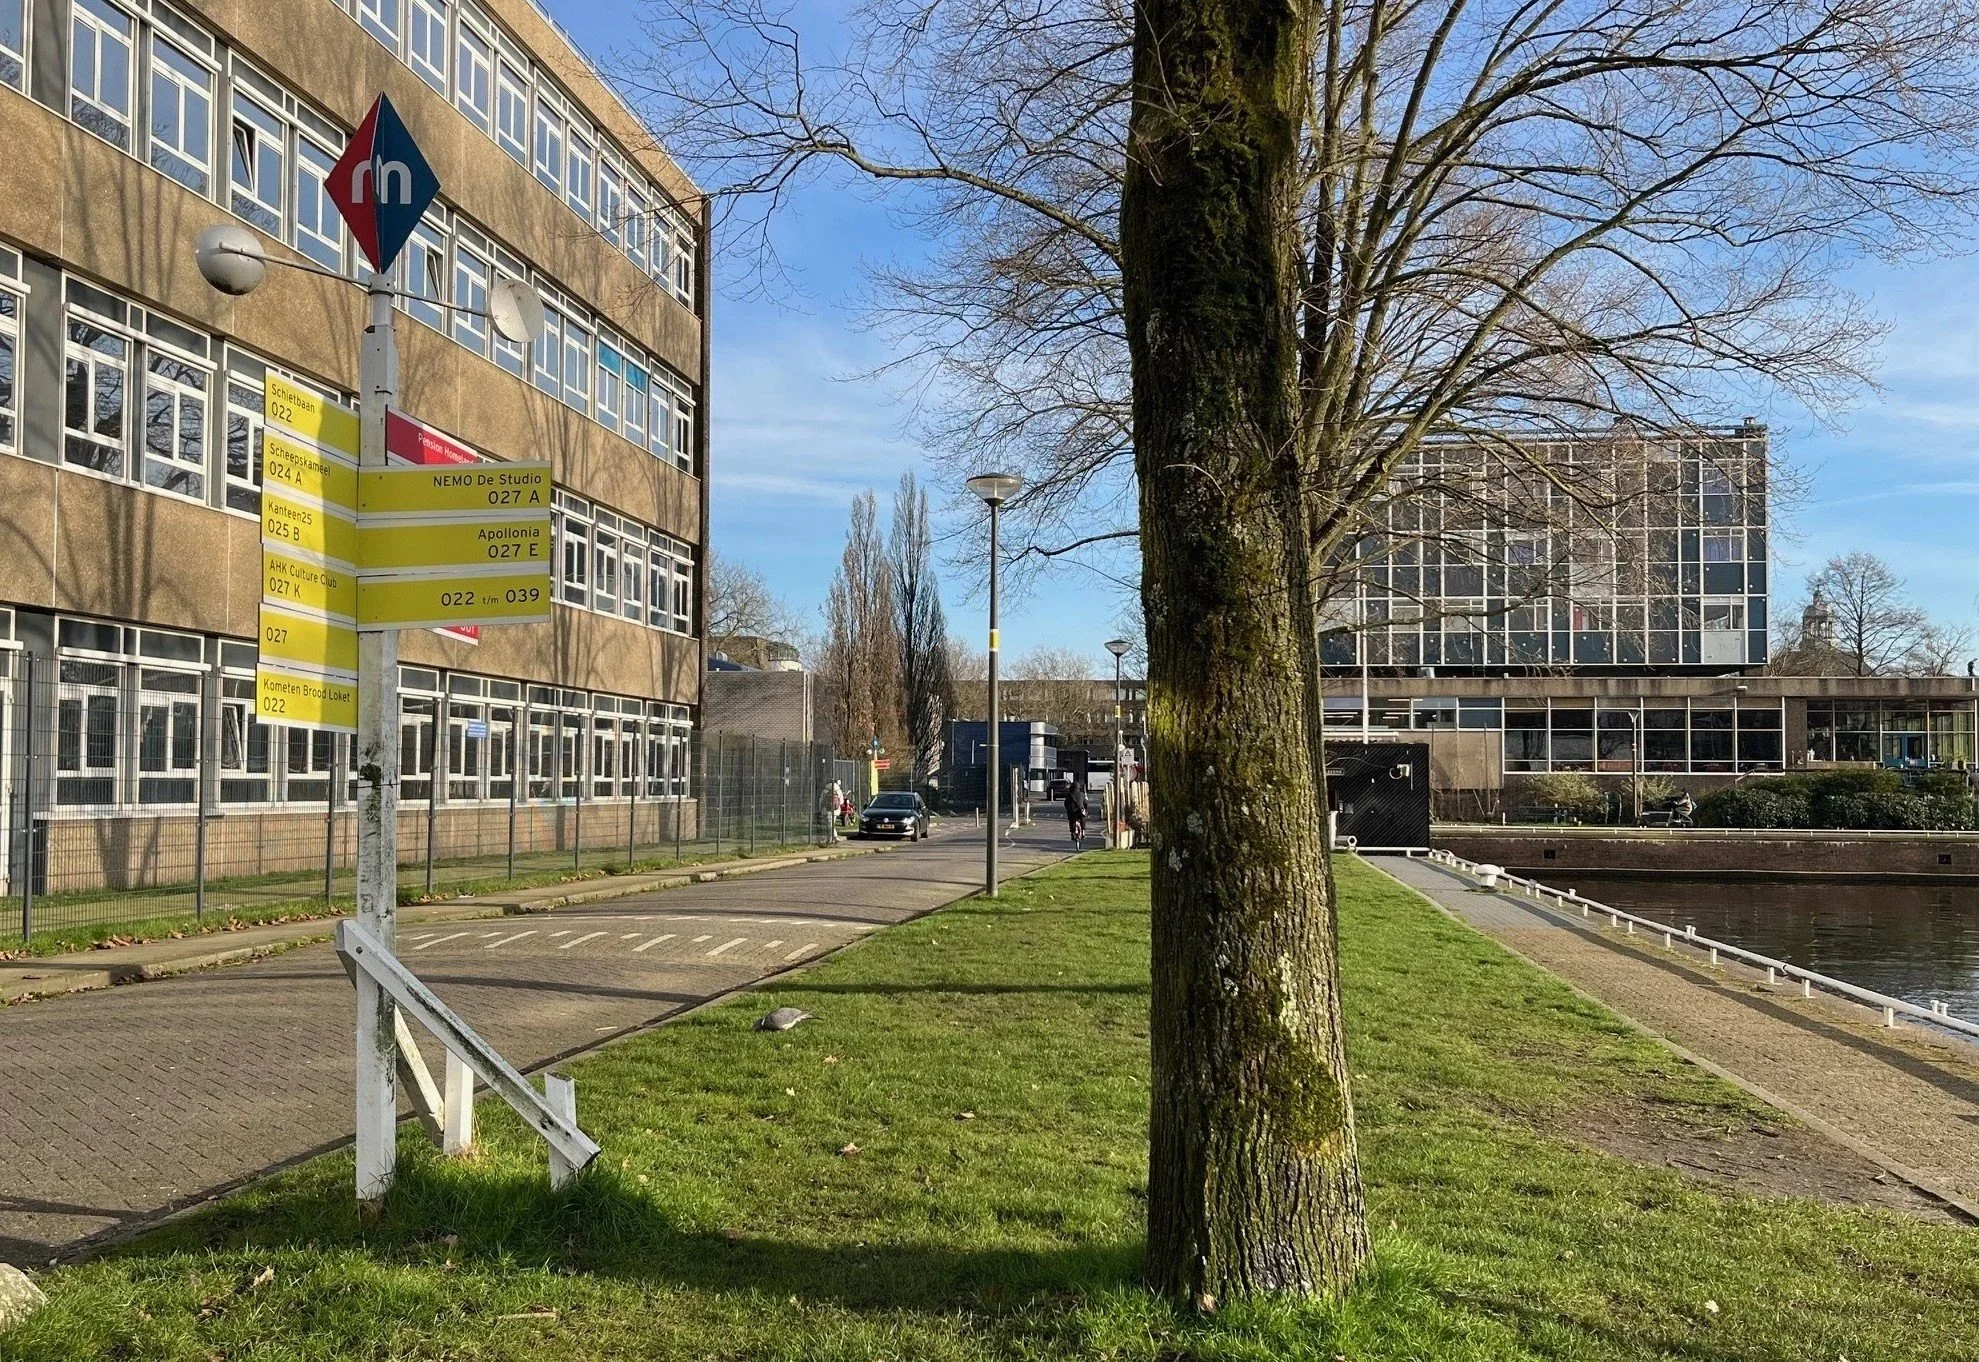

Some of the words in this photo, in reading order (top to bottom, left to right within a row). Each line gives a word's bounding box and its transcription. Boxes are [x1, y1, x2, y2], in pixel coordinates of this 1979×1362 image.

[271, 383, 315, 414] Schietbaan
[271, 402, 292, 423] 022
[418, 432, 443, 454] Pension
[270, 442, 331, 477] Scheepskameel
[269, 460, 291, 480] 024
[294, 471, 302, 486] A
[433, 474, 472, 487] NEMO
[477, 474, 494, 486] De
[499, 473, 541, 485] Studio
[488, 490, 521, 505] 027
[529, 490, 540, 504] A
[268, 500, 313, 526] Kanteen25
[268, 518, 289, 538] 025
[294, 526, 300, 541] B
[478, 527, 540, 542] Apollonia
[488, 543, 521, 558] 027
[529, 543, 539, 556] E
[269, 558, 287, 574] AHK
[290, 565, 318, 583] Culture
[320, 573, 337, 588] Club
[269, 577, 290, 596] 027
[294, 584, 301, 599] K
[441, 592, 475, 607] 022
[482, 595, 499, 605] t/m
[505, 588, 540, 603] 039
[266, 626, 288, 644] 027
[263, 678, 301, 695] Kometen
[303, 684, 326, 699] Brood
[328, 688, 350, 703] Loket
[263, 697, 286, 714] 022
